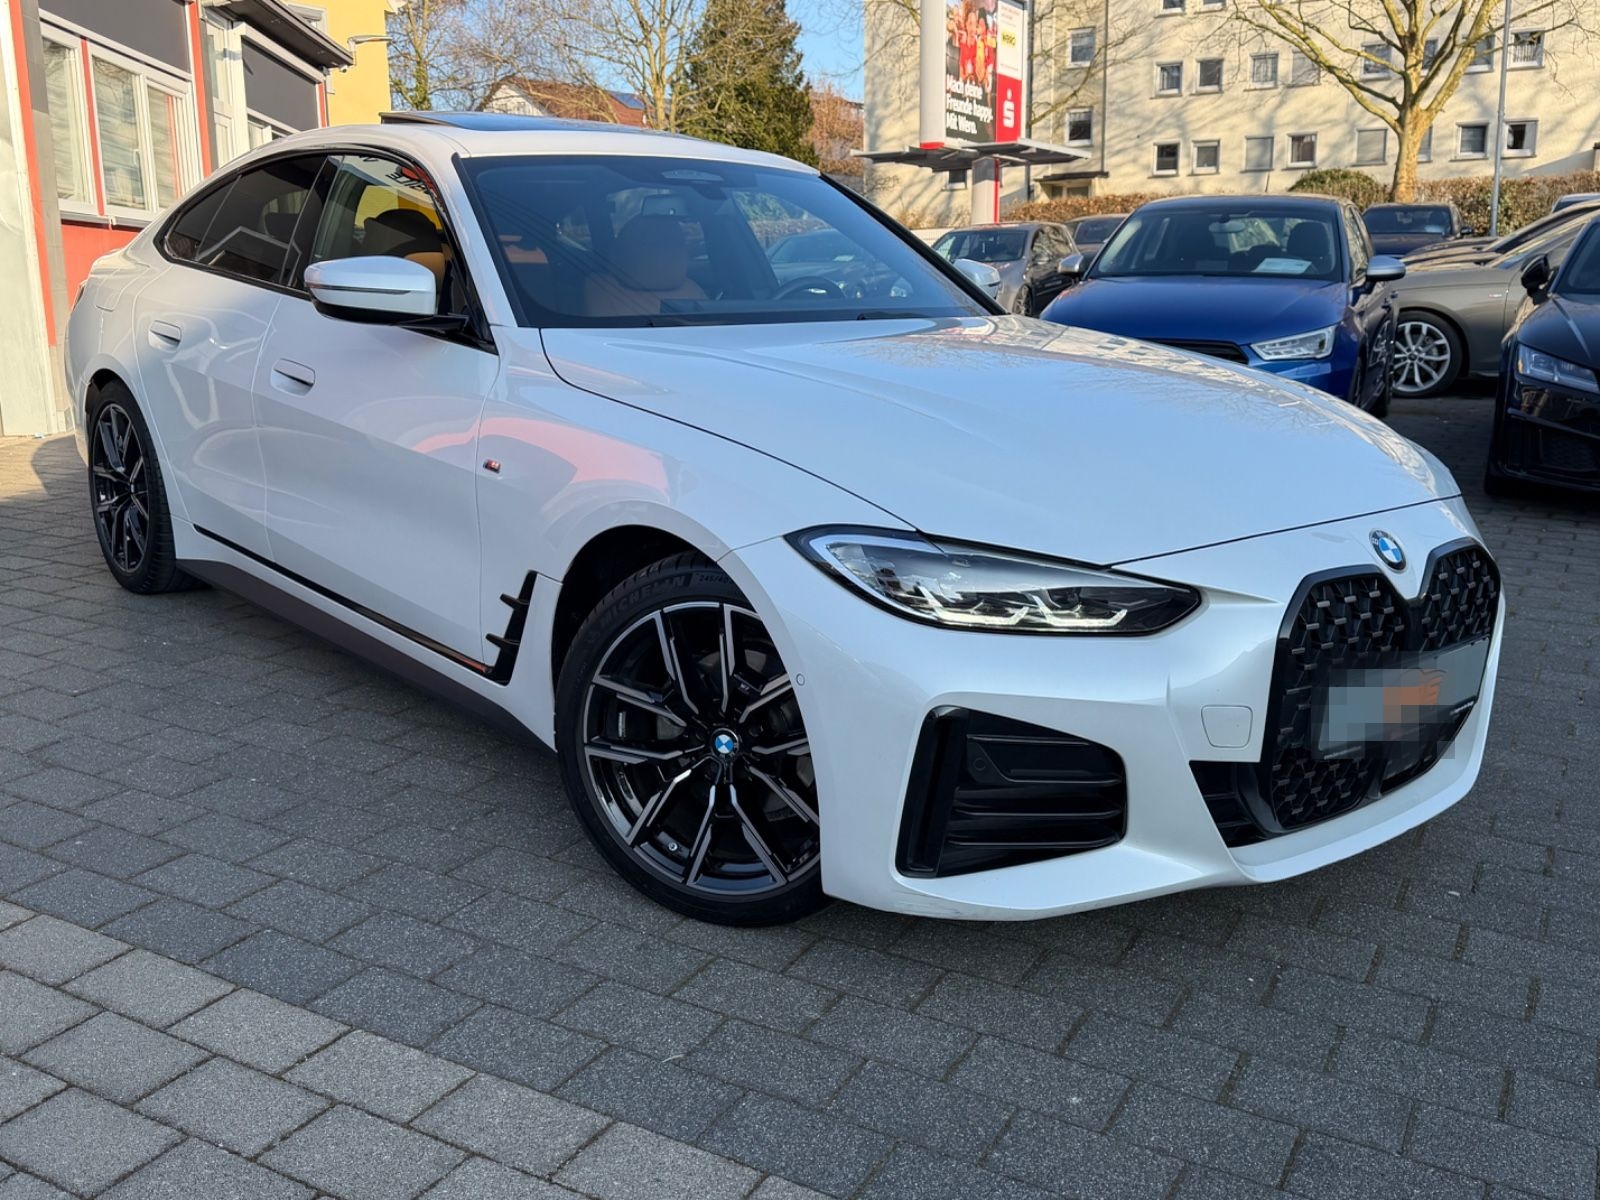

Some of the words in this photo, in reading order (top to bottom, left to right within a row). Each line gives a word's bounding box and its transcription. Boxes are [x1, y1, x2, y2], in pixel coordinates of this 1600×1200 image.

[946, 74, 964, 93] Mach
[965, 78, 983, 99] deine
[946, 94, 972, 115] Freunde
[973, 99, 993, 123] happy.
[946, 112, 958, 129] Mit
